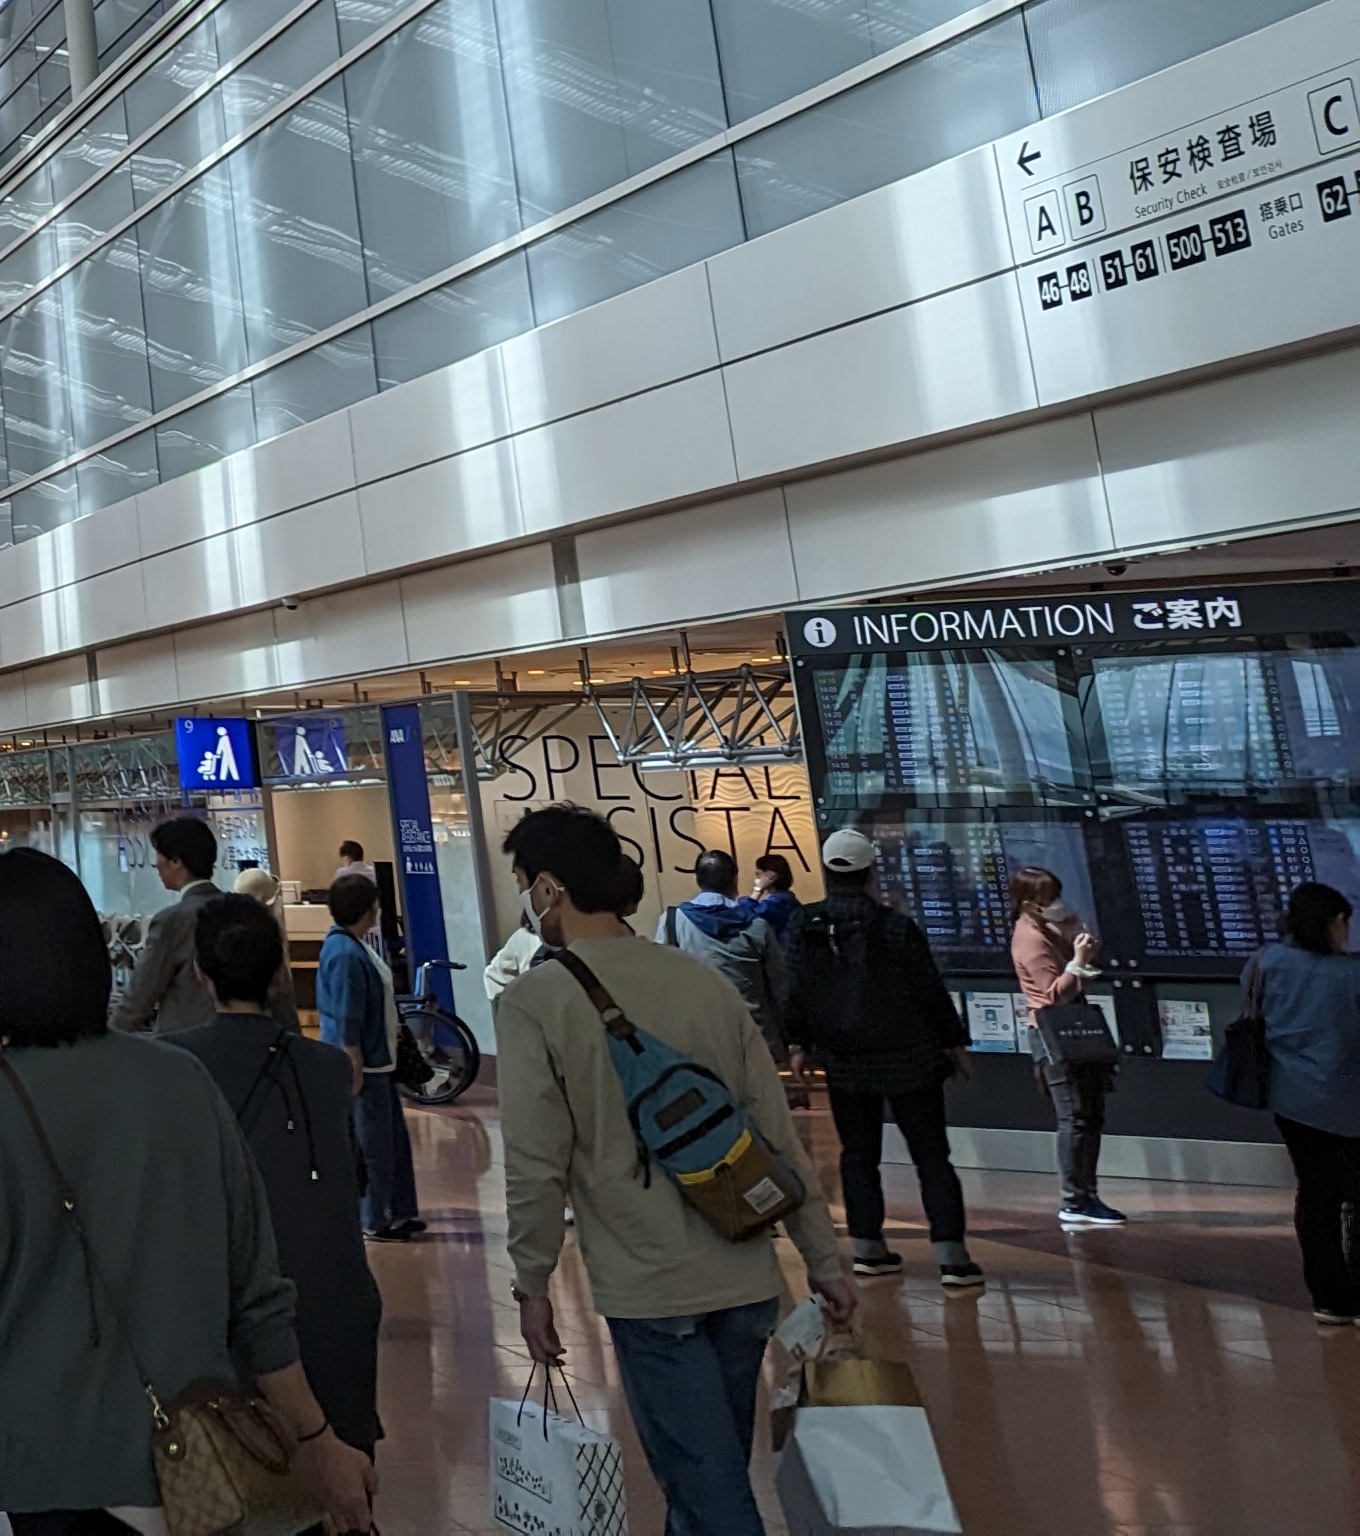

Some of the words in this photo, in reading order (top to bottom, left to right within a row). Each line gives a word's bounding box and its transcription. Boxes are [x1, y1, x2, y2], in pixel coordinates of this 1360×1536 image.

[1036, 205, 1057, 241] A
[1075, 190, 1094, 226] B
[1129, 110, 1277, 196] 保安検査場
[1323, 95, 1349, 136] C
[1134, 195, 1174, 219] Security
[1176, 183, 1208, 204] Check
[1259, 192, 1304, 224] 搭乗口
[1268, 218, 1305, 241] Gates
[853, 602, 1116, 646] INFORMATION
[1132, 596, 1243, 630] ご案内
[499, 734, 802, 801] SPECIAL
